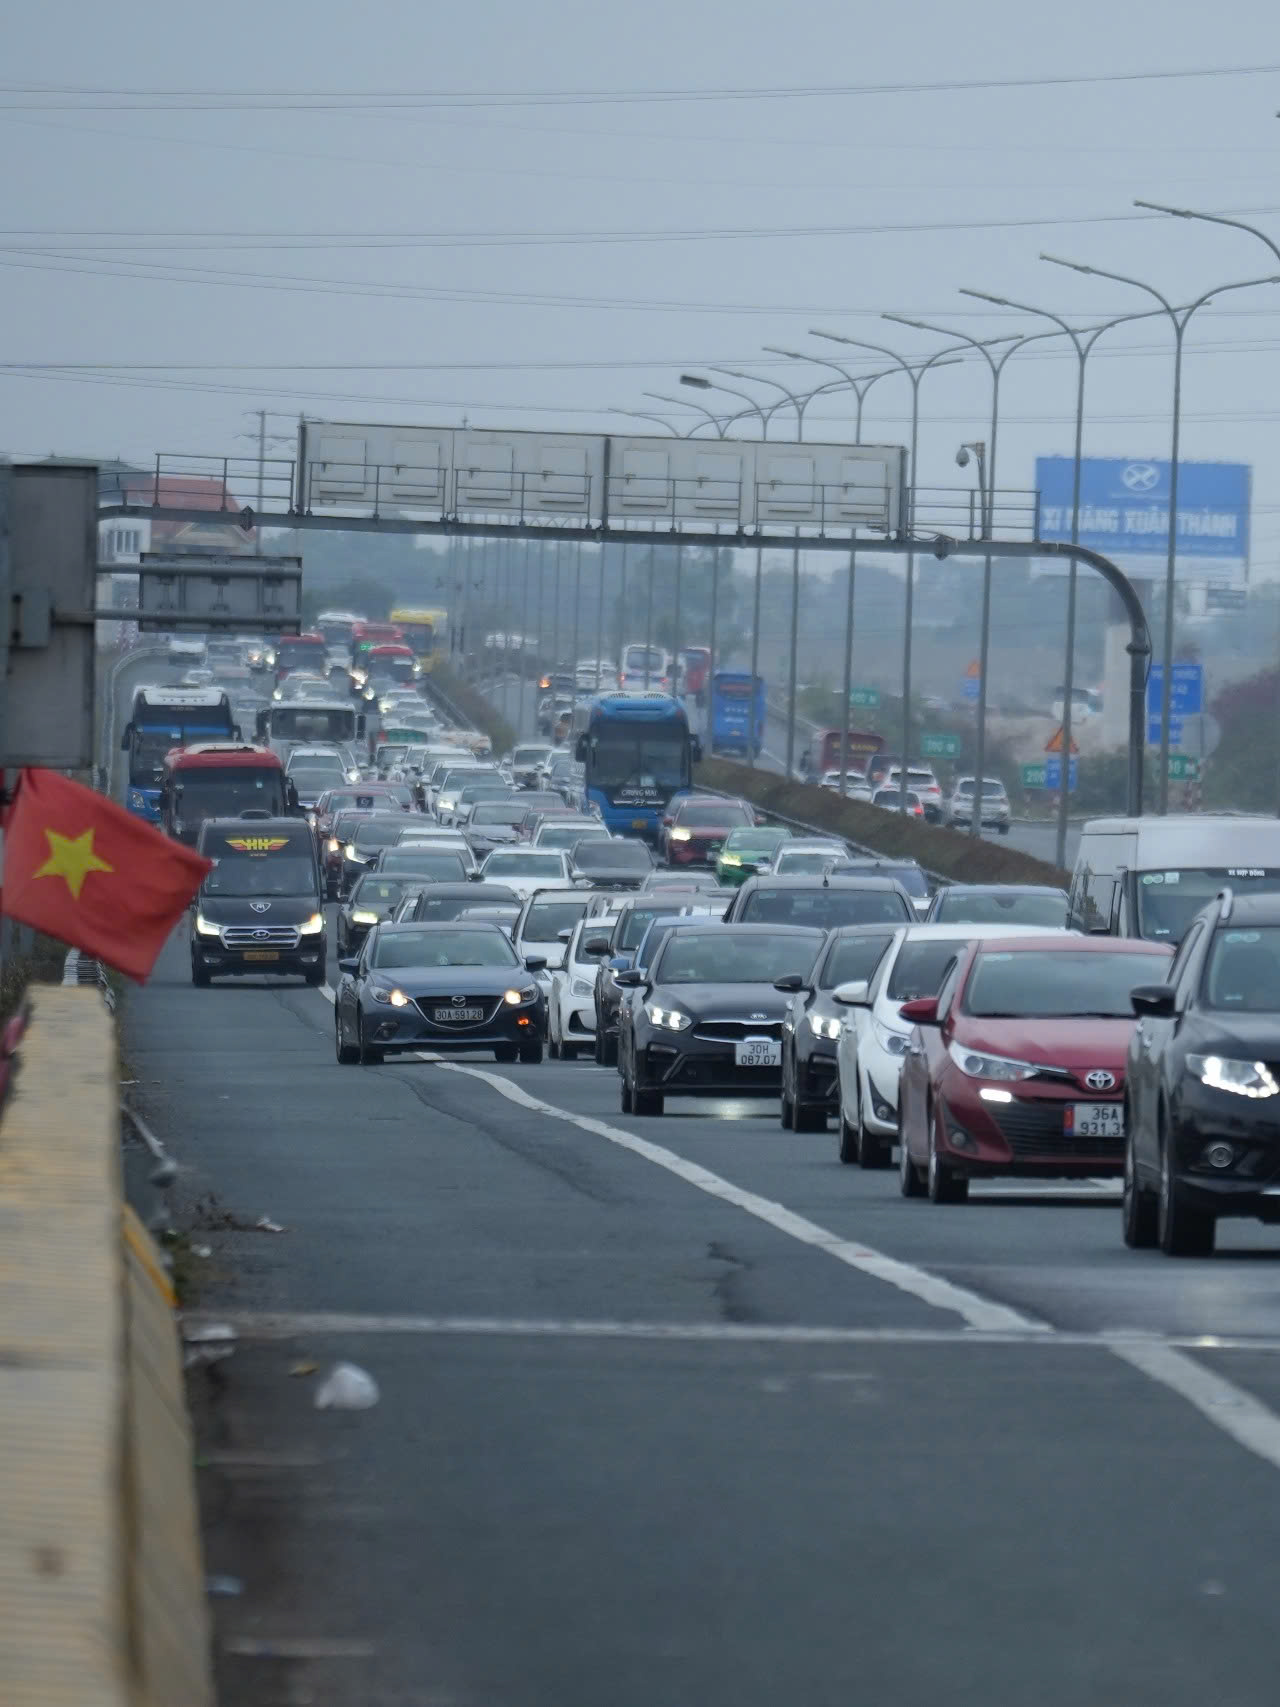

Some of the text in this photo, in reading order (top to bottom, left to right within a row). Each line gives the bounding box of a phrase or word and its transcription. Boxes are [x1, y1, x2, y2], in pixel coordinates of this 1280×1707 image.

[749, 1044, 769, 1055] 30H
[741, 1055, 777, 1065] 087.07
[1092, 1107, 1119, 1121] 36A
[1080, 1122, 1122, 1136] 931.3
